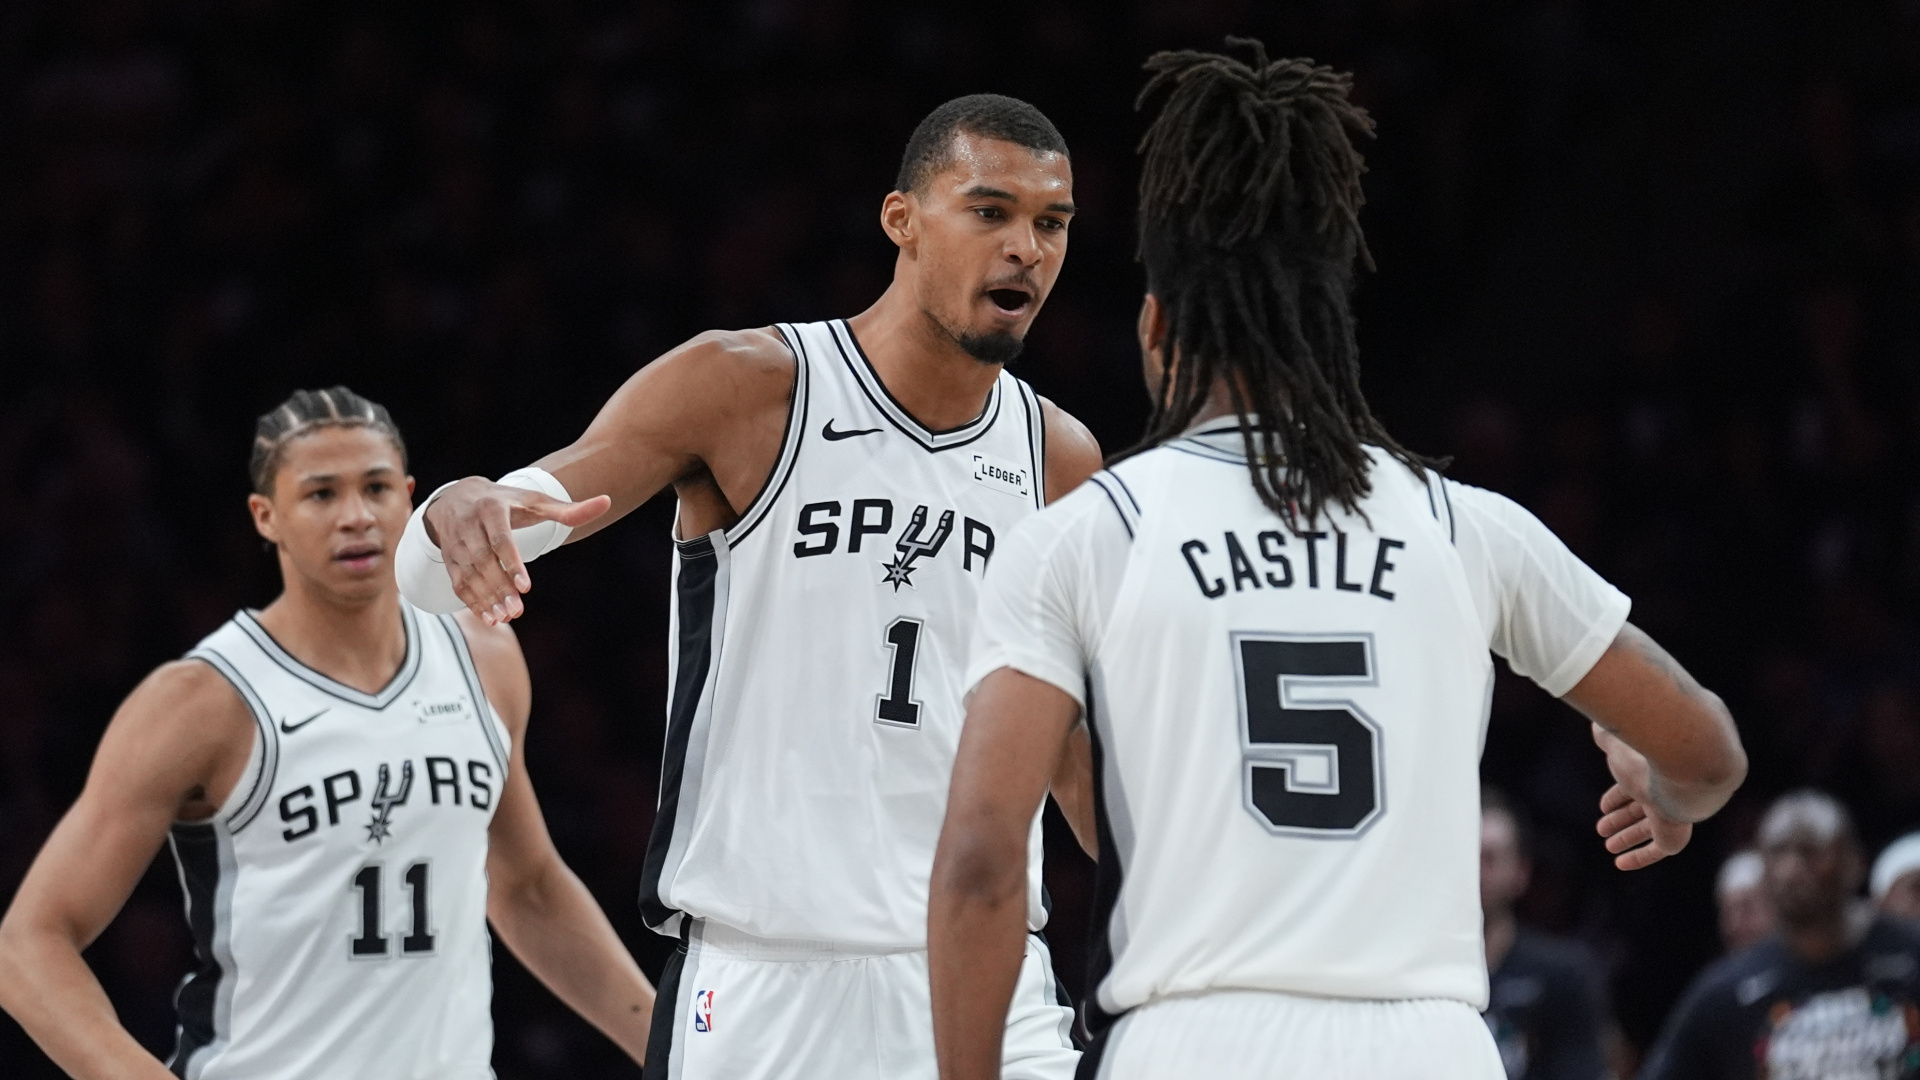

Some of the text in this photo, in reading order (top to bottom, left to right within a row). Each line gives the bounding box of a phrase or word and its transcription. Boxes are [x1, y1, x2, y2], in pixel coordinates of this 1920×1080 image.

[981, 463, 1022, 486] LEDGER
[793, 498, 995, 592] SPUR
[1181, 530, 1406, 601] CASTLE
[874, 616, 924, 730] 1
[1229, 630, 1388, 841] 5
[279, 757, 492, 844] SPURS
[350, 859, 437, 960] 11
